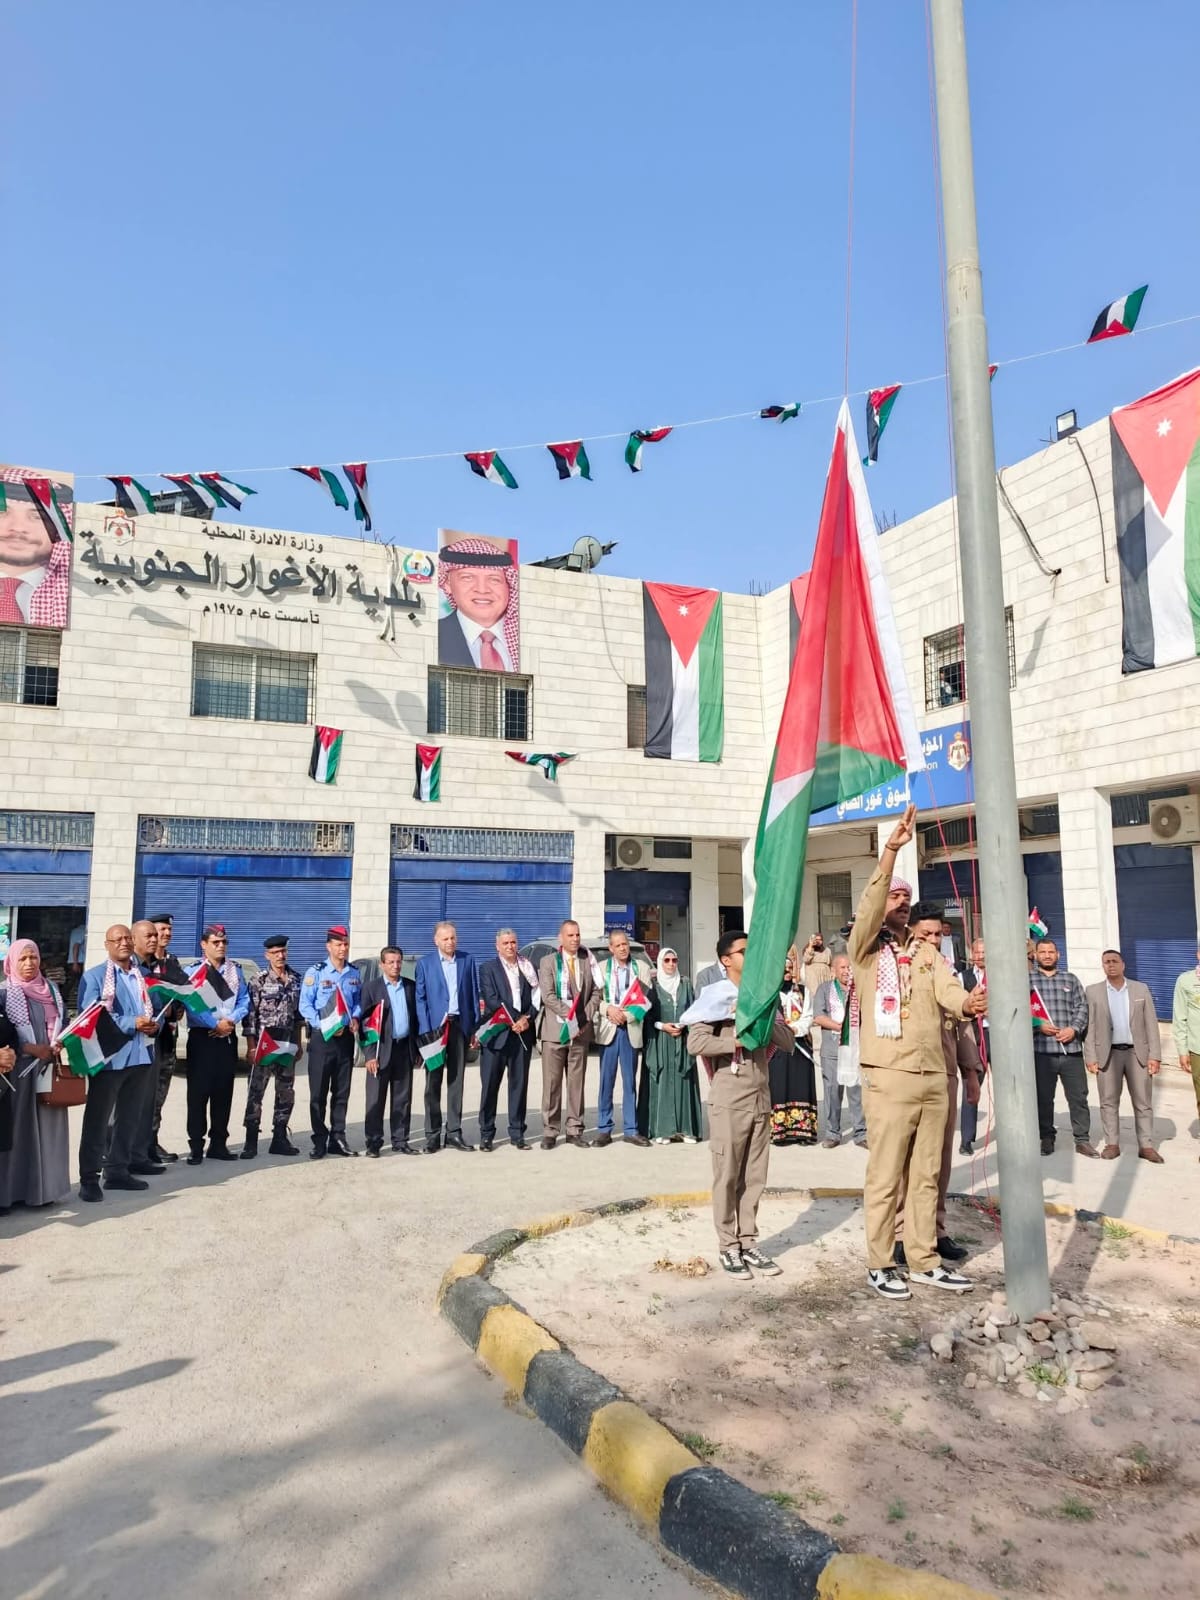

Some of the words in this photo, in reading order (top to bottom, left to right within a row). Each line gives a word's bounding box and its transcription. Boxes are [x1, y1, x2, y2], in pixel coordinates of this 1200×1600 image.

[201, 521, 246, 540] المحلية
[290, 536, 323, 553] وزارة
[78, 530, 220, 594] الجنوبية
[225, 552, 337, 598] الأغوار
[345, 563, 421, 621] بلدية
[249, 607, 271, 620] عام
[274, 609, 320, 624] تأسست
[864, 788, 882, 812] غور
